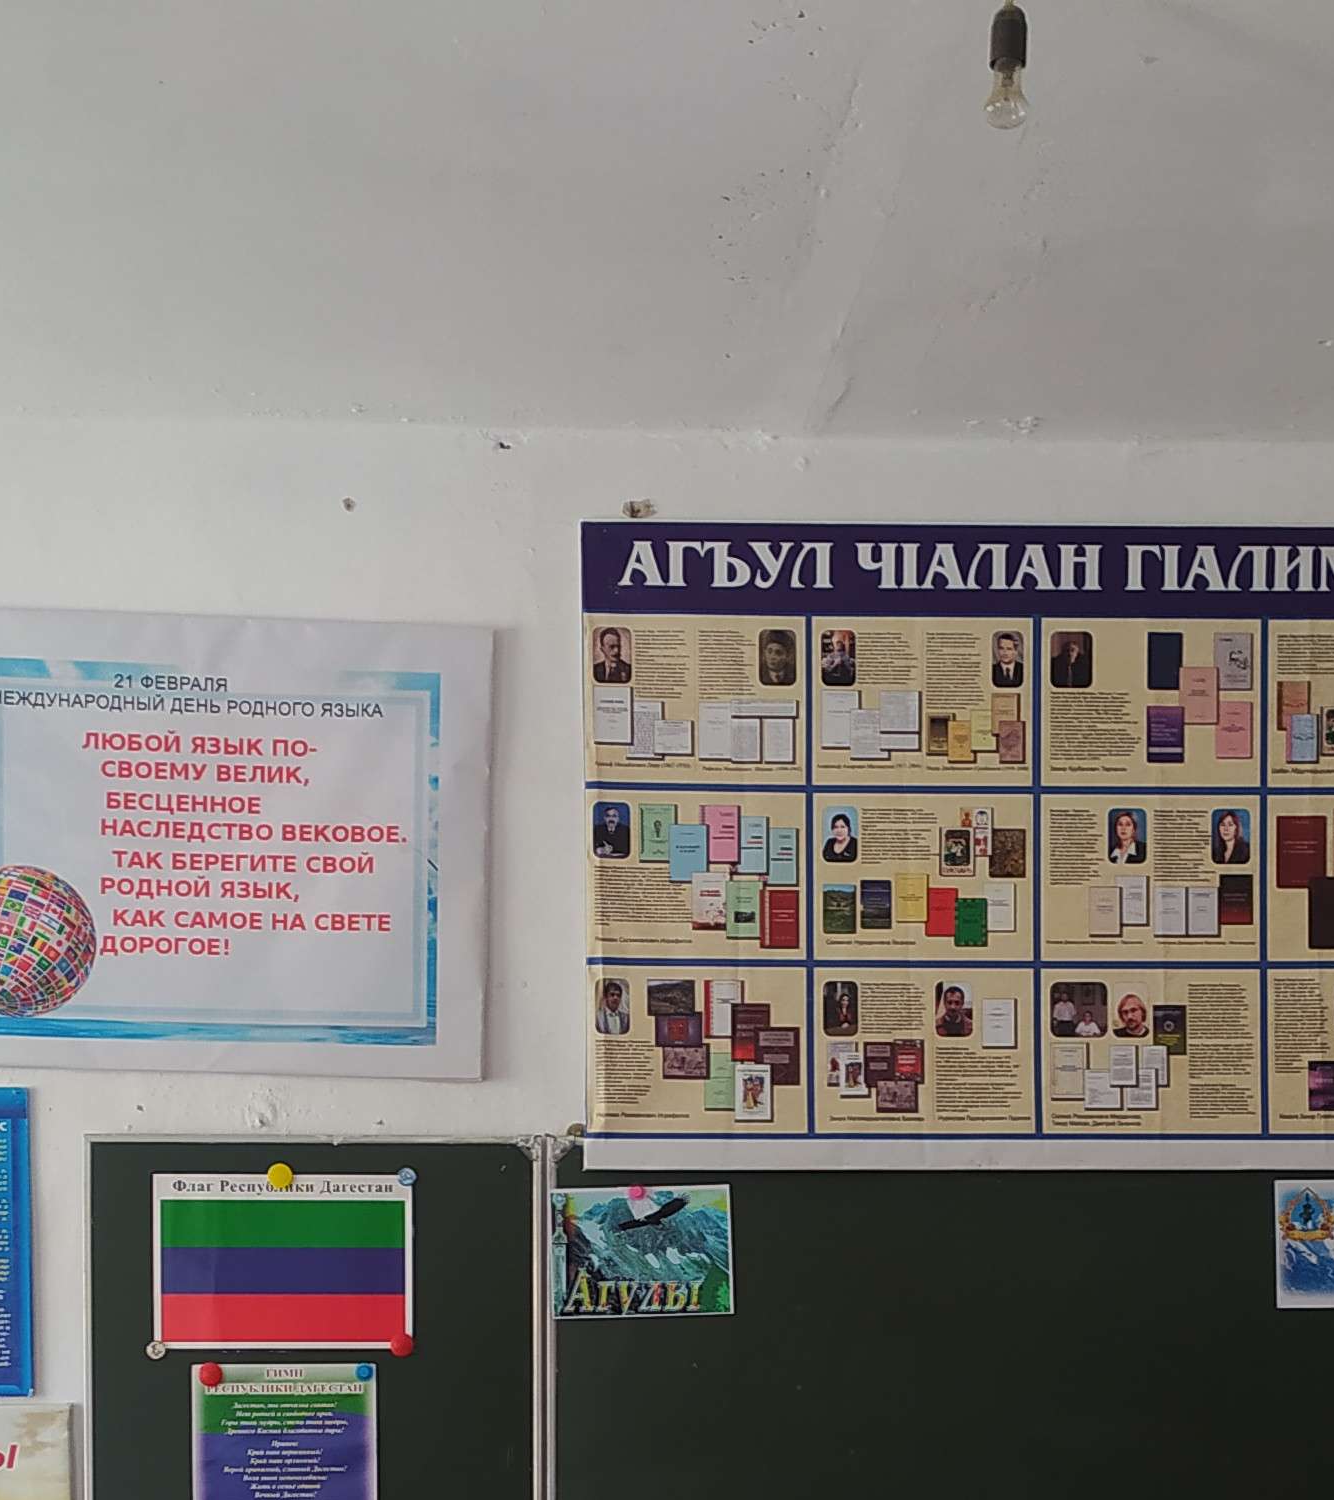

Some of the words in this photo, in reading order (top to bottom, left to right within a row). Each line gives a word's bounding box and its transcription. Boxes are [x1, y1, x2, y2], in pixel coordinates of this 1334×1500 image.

[618, 541, 834, 593] АГЪУЛ
[113, 674, 134, 690] 21
[140, 674, 228, 693] ФЕВРАЛЯ
[170, 697, 221, 716] ДЕНЬ
[227, 699, 315, 718] РОДНОГО
[321, 702, 384, 718] ЯЗЫКА
[81, 730, 181, 754] ЛЮБОЙ
[191, 736, 264, 756] ЯЗЫК
[272, 740, 318, 758] ПО-
[100, 760, 208, 781] СВОЕМУ
[216, 764, 310, 786] ВЕЛИК,
[106, 792, 261, 815] БЕСЦЕННОЕ
[100, 819, 273, 843] НАСЛЕДСТВО
[281, 824, 407, 843] ВЕКОВОЕ.
[112, 850, 163, 870] ТАК
[171, 853, 297, 873] БЕРЕГИТЕ
[305, 851, 374, 874] СВОЙ
[100, 874, 210, 899] РОДНОЙ
[220, 880, 300, 902] ЯЗЫК,
[113, 909, 166, 928] КАК
[173, 911, 263, 931] САМОЕ
[271, 912, 307, 931] НА
[314, 914, 391, 932] СВЕТЕ
[99, 936, 230, 957] ДОРОГОЕ!
[172, 1180, 214, 1194] Флаг
[319, 1180, 394, 1195] Дагестан
[265, 1368, 304, 1379] ГИМН
[207, 1384, 294, 1394] РЕСПУБЛИКИ
[295, 1384, 363, 1395] ДАГЕСТАН
